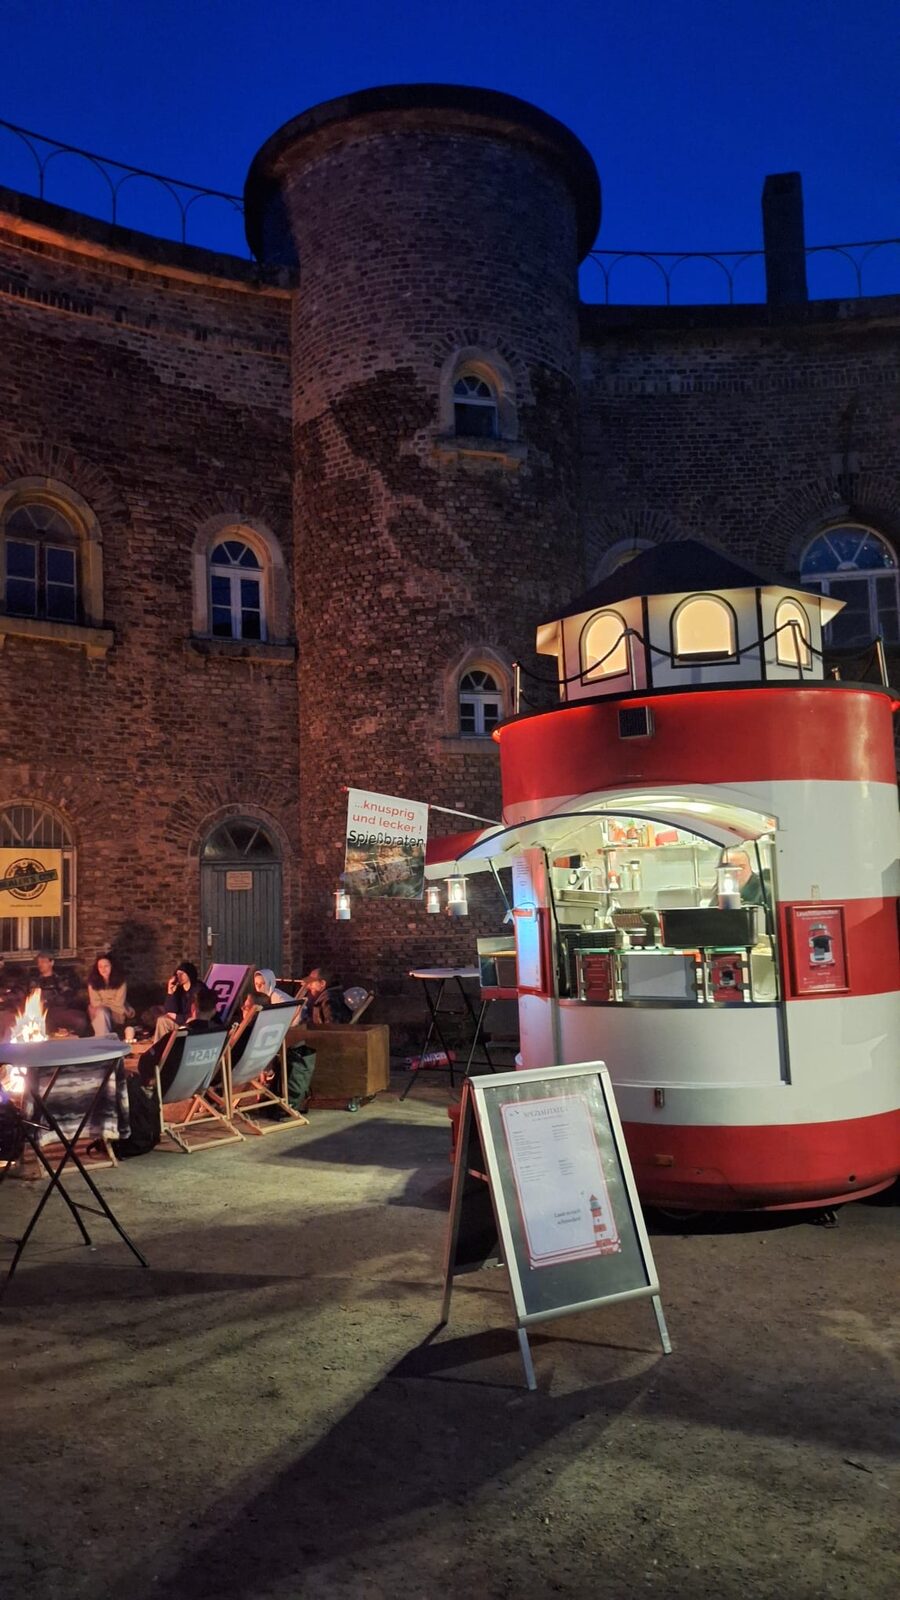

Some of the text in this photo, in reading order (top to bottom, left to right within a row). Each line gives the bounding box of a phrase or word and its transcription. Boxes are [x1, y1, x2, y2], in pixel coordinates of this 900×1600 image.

[352, 814, 375, 825] und
[379, 817, 416, 833] lecker
[349, 830, 424, 847] Spießbraten
